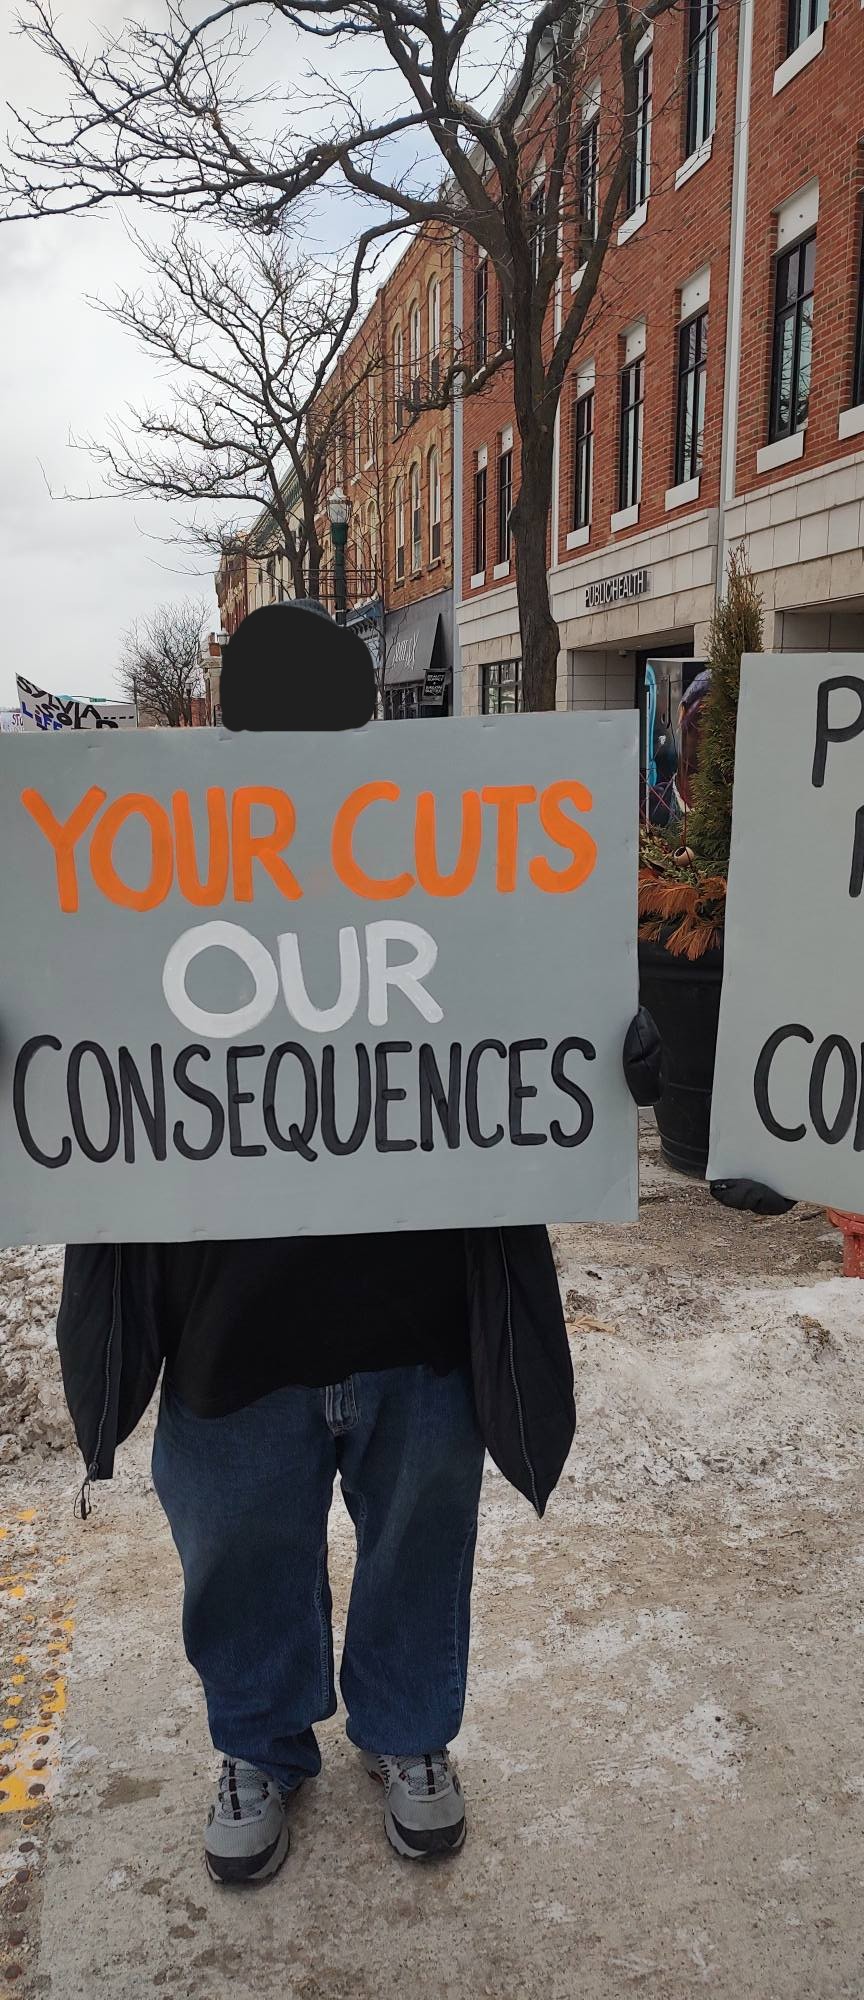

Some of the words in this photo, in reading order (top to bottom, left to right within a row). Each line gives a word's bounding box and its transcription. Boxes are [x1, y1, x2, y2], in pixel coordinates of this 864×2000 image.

[585, 581, 611, 607] PUBLIC
[612, 570, 646, 601] HEALTH
[22, 787, 302, 912] YOUR
[333, 782, 596, 899] CUTS
[163, 921, 443, 1037] OUR
[13, 1035, 596, 1168] CONSEQUENCES
